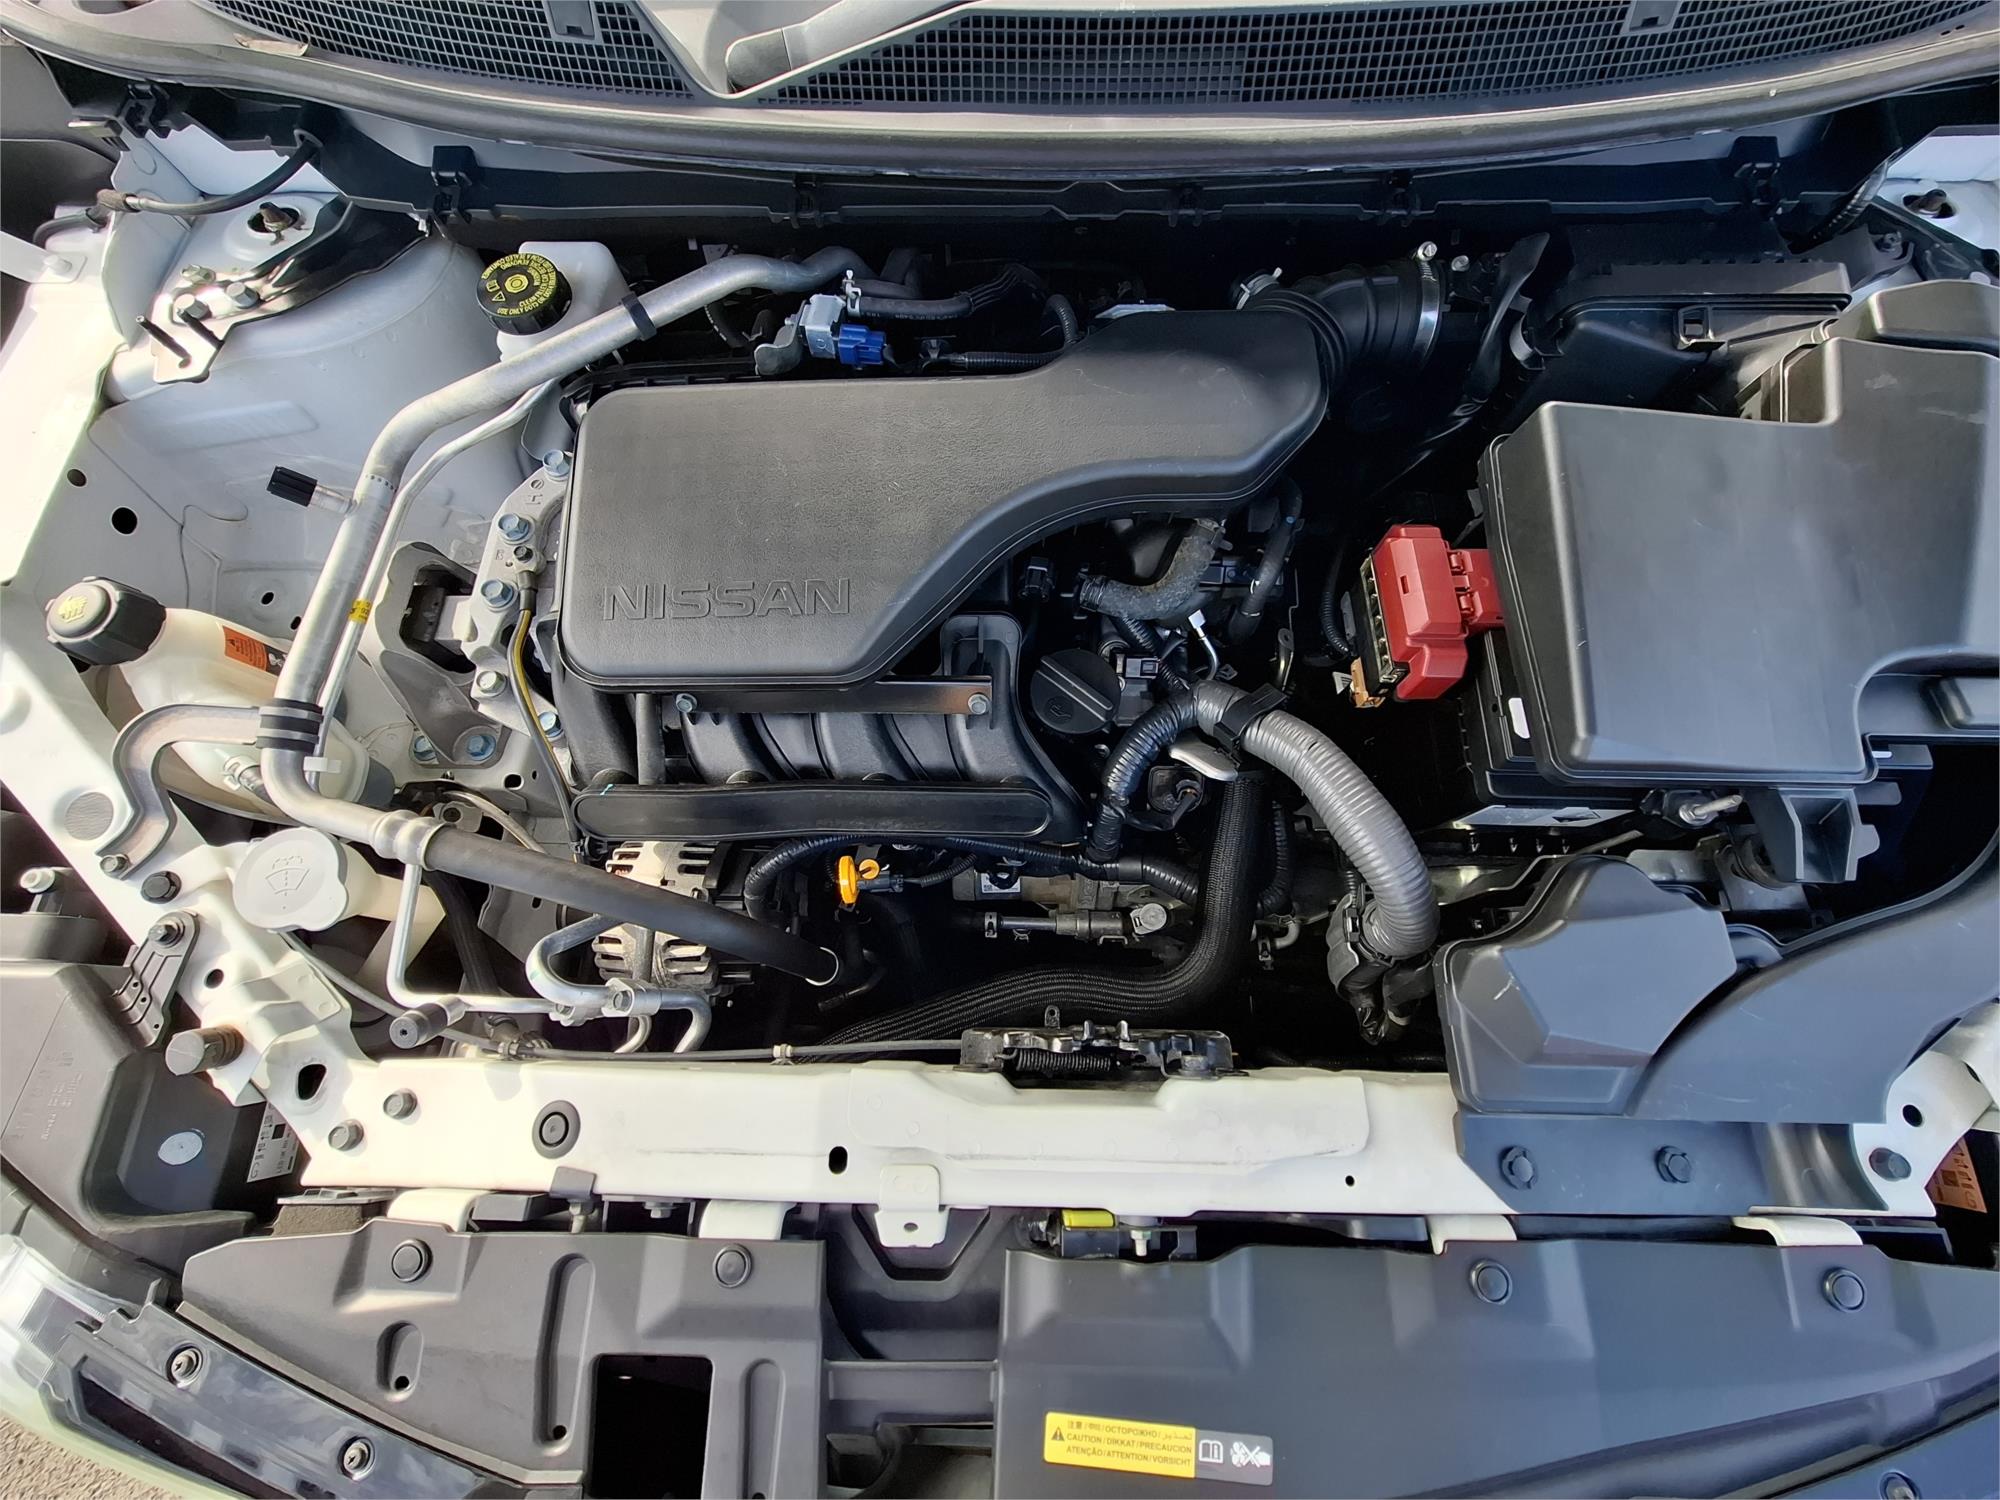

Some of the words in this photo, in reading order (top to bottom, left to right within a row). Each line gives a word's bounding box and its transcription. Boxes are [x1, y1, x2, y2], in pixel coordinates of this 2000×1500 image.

[519, 296, 537, 307] CLEAN
[509, 307, 524, 315] ONLY
[602, 577, 850, 621] NISSAN
[1067, 1433, 1102, 1444] CAUTION
[1106, 1438, 1135, 1447] DIKKAT
[1066, 1445, 1102, 1457] ATENÇÃO
[1106, 1450, 1149, 1461] ATTENTION
[1152, 1455, 1192, 1467] VORSICHT
